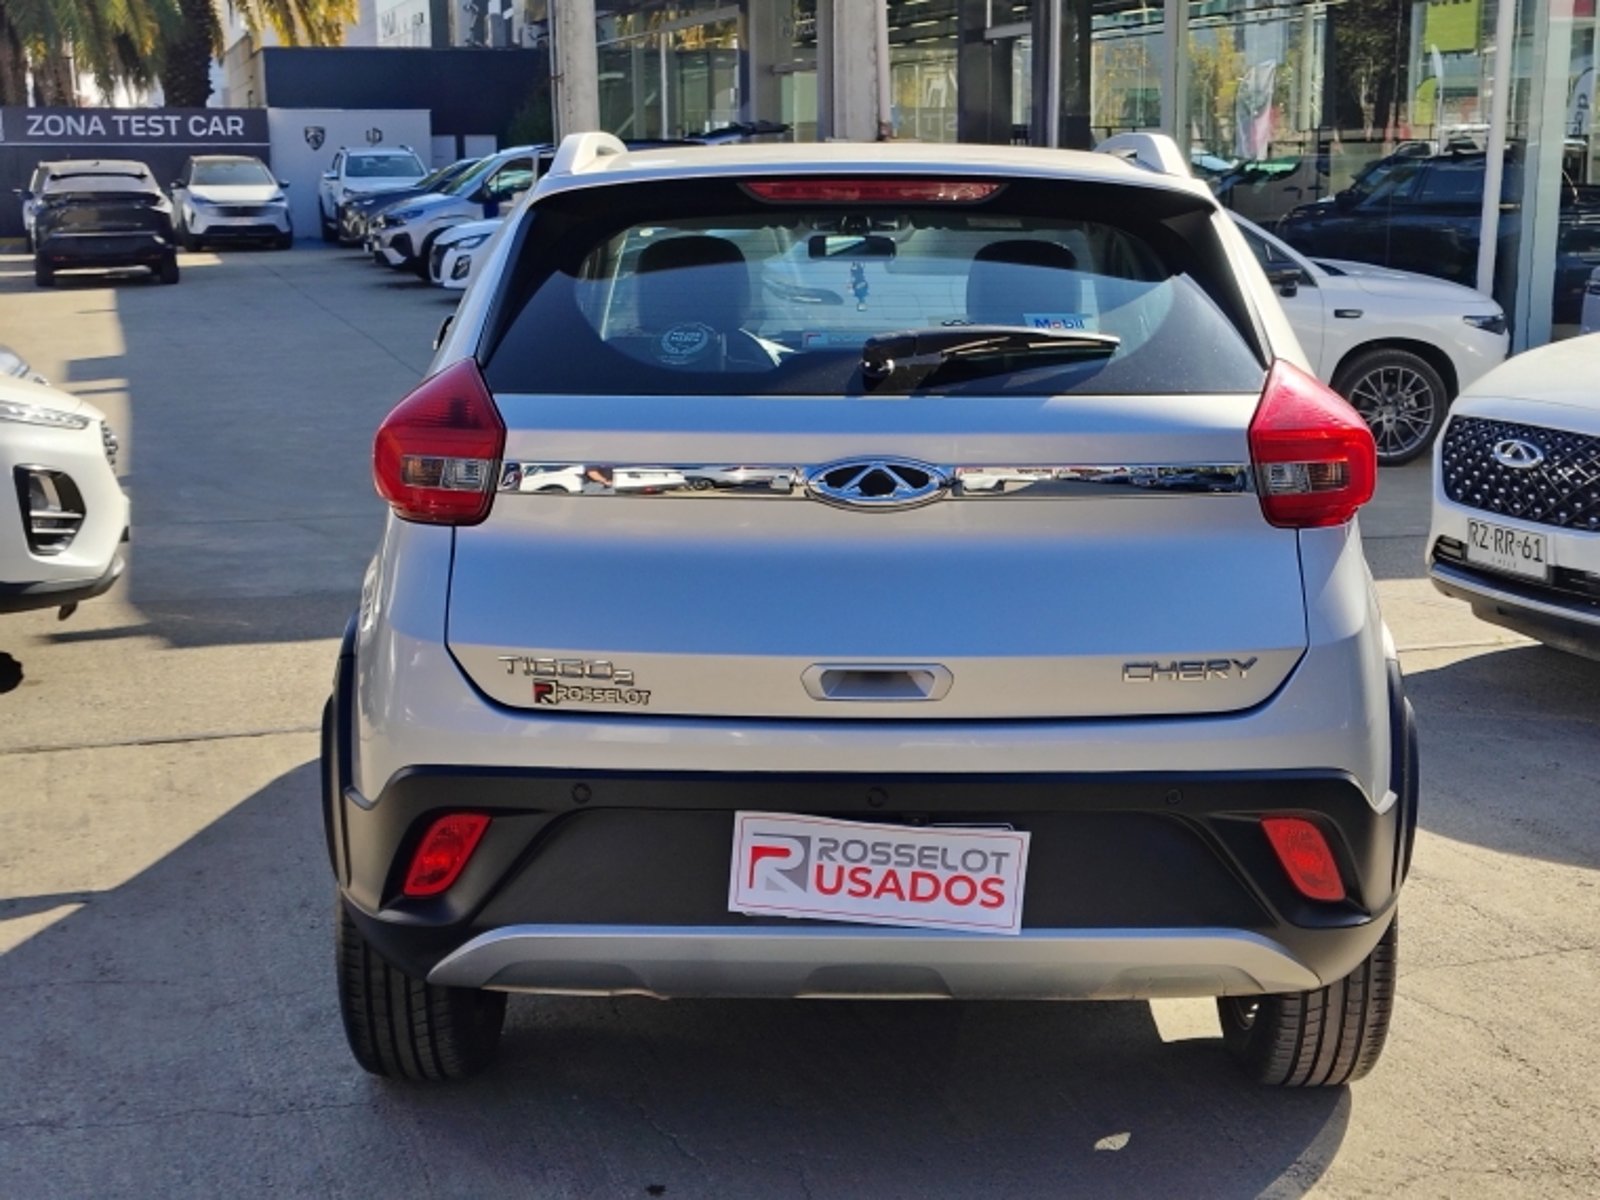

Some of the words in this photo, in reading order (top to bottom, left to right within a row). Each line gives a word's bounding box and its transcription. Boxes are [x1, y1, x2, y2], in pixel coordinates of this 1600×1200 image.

[26, 115, 106, 136] ZONA
[112, 115, 182, 136] TEST
[188, 115, 244, 136] CAR
[1034, 318, 1085, 329] Mobil
[1121, 656, 1258, 683] CHERY
[817, 837, 1010, 875] ROSSELOT
[814, 864, 1006, 910] USADOS
